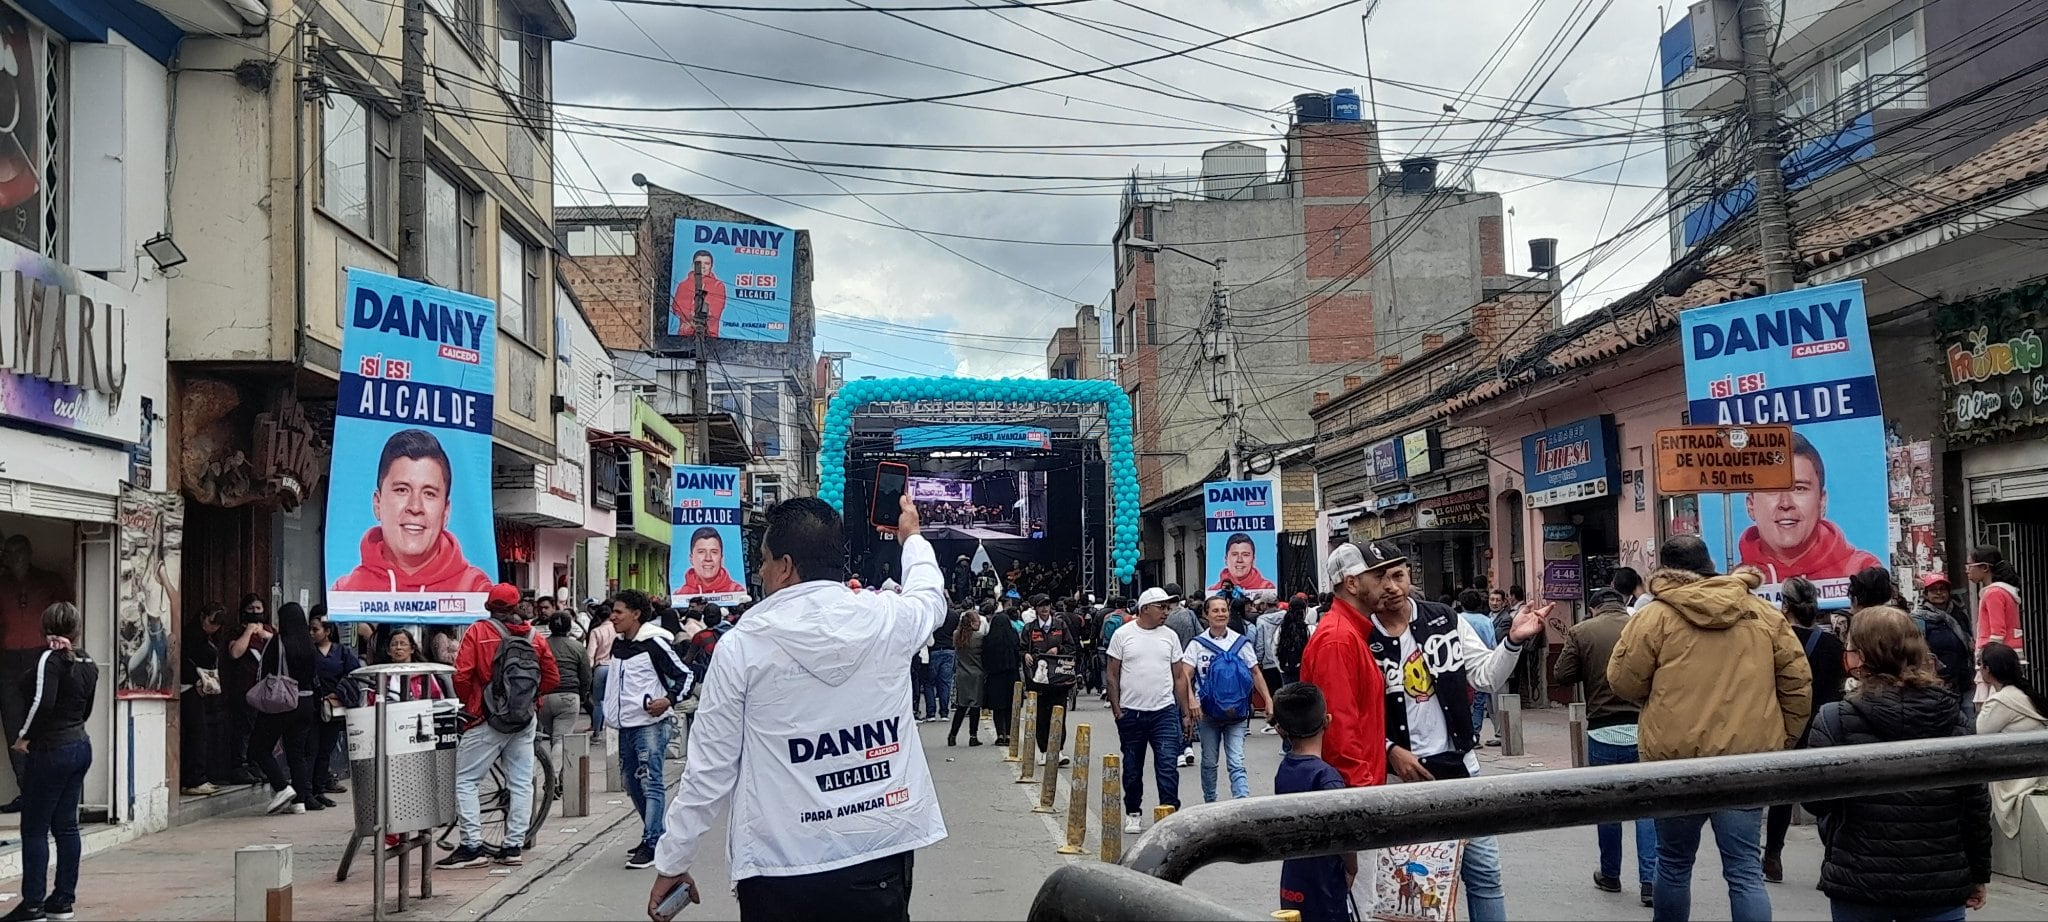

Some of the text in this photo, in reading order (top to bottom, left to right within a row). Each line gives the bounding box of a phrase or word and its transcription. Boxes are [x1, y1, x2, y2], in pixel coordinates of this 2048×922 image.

[695, 225, 784, 249] DANNY
[740, 248, 776, 256] CAICEDO
[757, 275, 776, 287] ES!
[738, 290, 774, 299] ALCALDE
[353, 287, 487, 350] DANNY
[1693, 299, 1852, 360] DANNY
[442, 347, 477, 362] CAICEDO
[1796, 341, 1846, 356] CAICEDO
[360, 354, 410, 379] ¡SÍ ES!
[1711, 373, 1765, 398] ¡SÍ ES!
[359, 380, 476, 428] ALCALDE
[1718, 384, 1854, 425] ALCALDE
[1660, 434, 1724, 450] ENTRADA
[1746, 433, 1786, 447] ALIDA
[1535, 437, 1591, 475] TERESA
[1677, 452, 1775, 467] DE VOLQUETAS
[677, 473, 735, 490] DANNY
[1700, 470, 1754, 484] A 50 mts
[1208, 486, 1268, 503] DANNY
[681, 509, 732, 523] ALCALDE
[1446, 503, 1470, 514] GUAVIO
[1216, 517, 1266, 531] ALCALDE
[360, 594, 464, 612] ¡PARA AVANZAR MÁS!
[788, 716, 899, 763] DANNY
[868, 745, 897, 757] CAICEDO
[825, 762, 889, 790] ALCALDE
[801, 787, 909, 823] ¡PARA AVANZAR MÁS!
